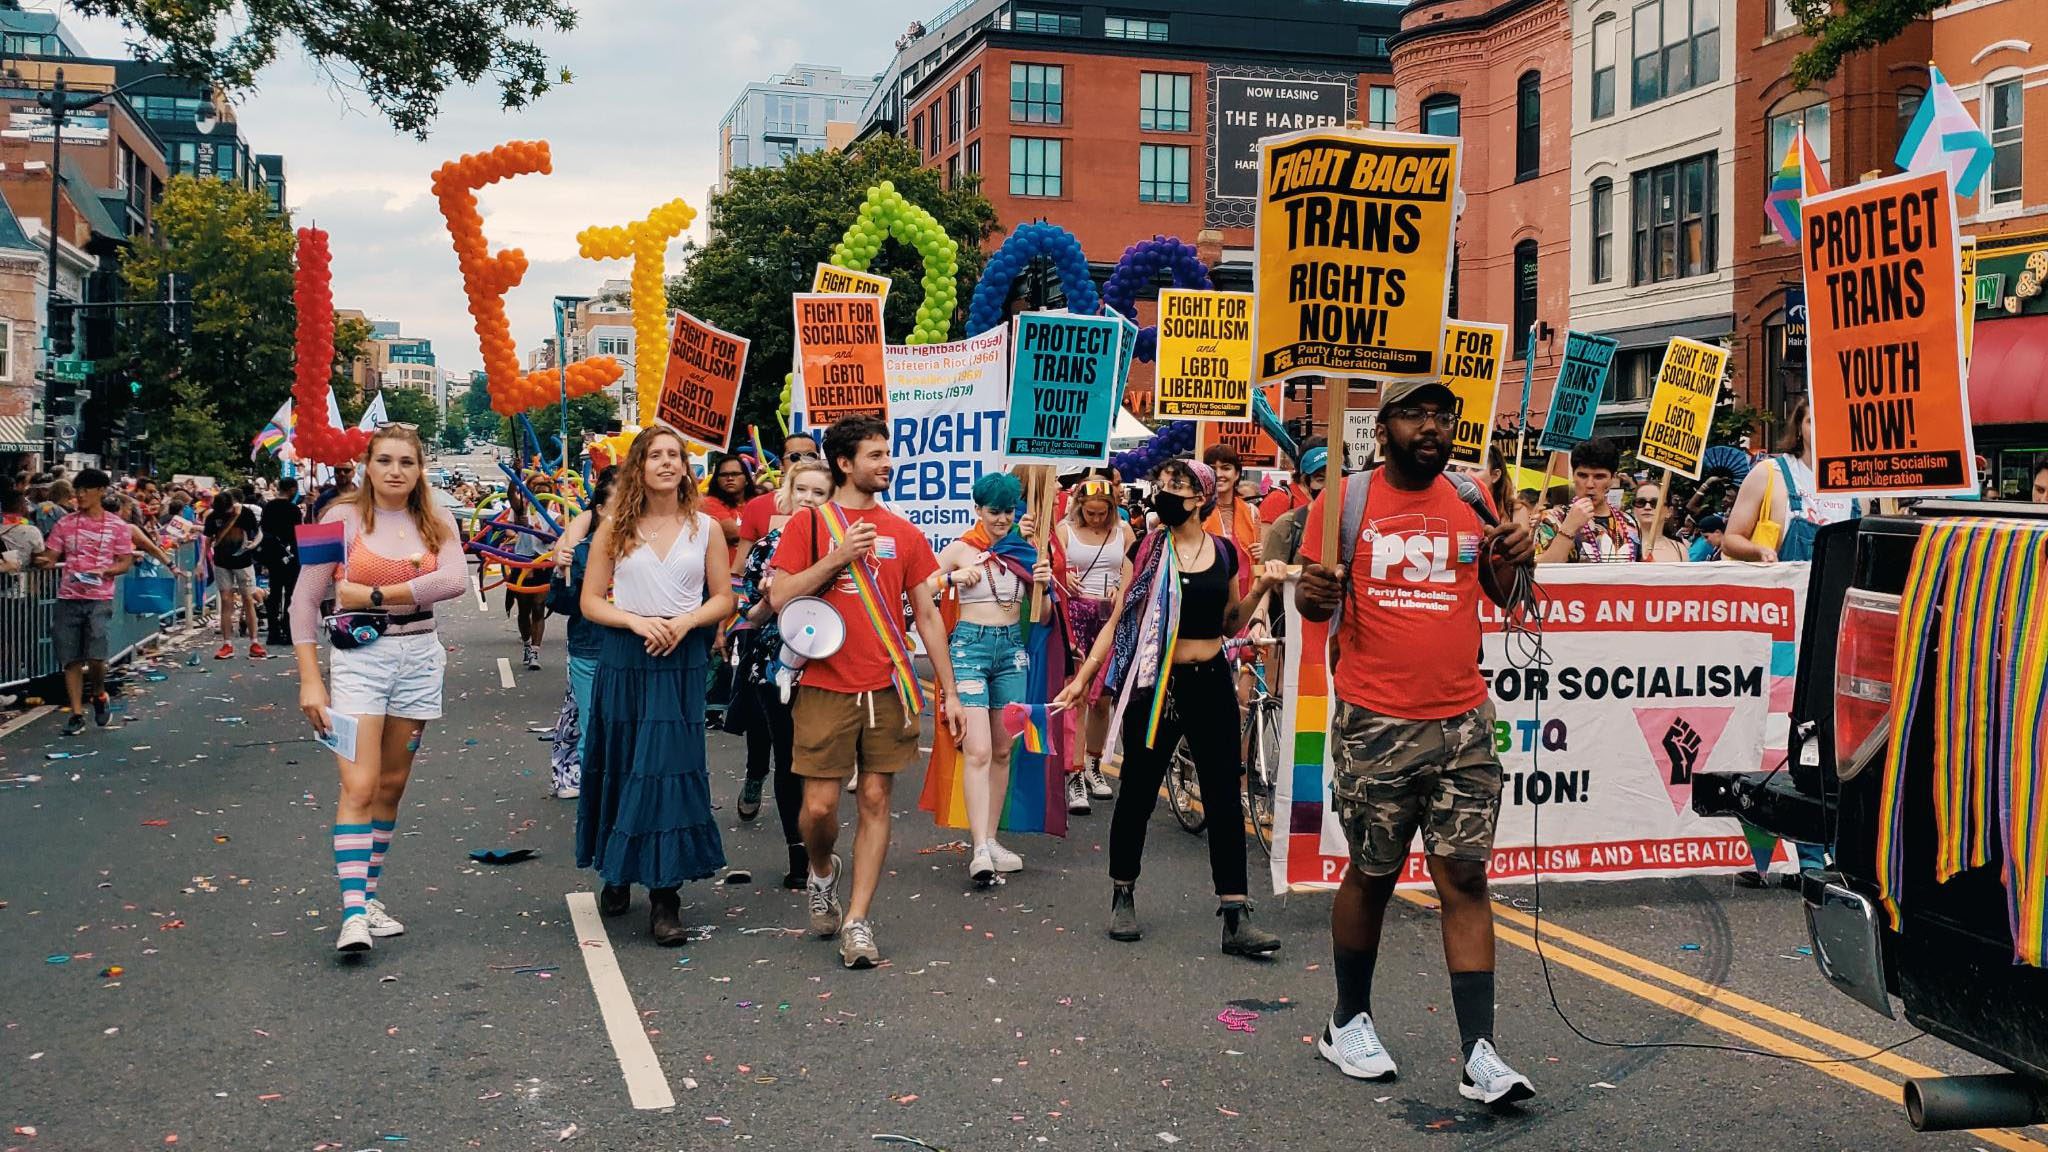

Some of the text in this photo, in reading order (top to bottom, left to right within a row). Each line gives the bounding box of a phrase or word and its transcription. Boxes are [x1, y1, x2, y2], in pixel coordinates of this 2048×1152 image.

[1247, 86, 1319, 101] NOW LEASING
[1226, 111, 1337, 129] THE HARPER
[1271, 148, 1449, 195] FIGHT BACK!
[1285, 196, 1422, 254] TRANS
[1809, 187, 1939, 272] PROTECT
[821, 272, 880, 293] FIGHT FOR
[1289, 262, 1406, 307] RIGHTS
[1826, 259, 1926, 330] TRANS
[804, 302, 874, 323] FIGHT FOR
[1168, 296, 1246, 319] FIGHT FOR
[802, 325, 879, 345] SOCIALISM
[1163, 317, 1249, 341] SOCIALISM
[1299, 303, 1389, 347] NOW!
[680, 320, 737, 362] FIGHT FOR
[1024, 323, 1112, 356] PROTECT
[1196, 341, 1219, 353] and
[1455, 331, 1493, 356] FOR
[1788, 337, 1803, 346] Hair
[673, 338, 736, 381] SOCIALISM
[833, 346, 854, 359] and
[887, 359, 940, 371] Cafeteria
[943, 356, 966, 369] Riot
[1297, 356, 1387, 370] and Liberation
[1298, 345, 1417, 362] Party for Socialism
[1669, 344, 1719, 375] FIGHT FOR
[64, 362, 71, 371] T
[689, 372, 709, 383] and
[823, 364, 864, 385] LGBTQ
[1033, 353, 1098, 385] TRANS
[1181, 356, 1229, 380] LGBTQ
[1838, 341, 1921, 399] YOUTH
[1161, 377, 1247, 400] LIBERATION
[1662, 363, 1717, 398] SOCIALISM
[677, 376, 713, 409] LGBTQ
[808, 384, 884, 407] LIBERATION
[888, 389, 909, 402] ight
[914, 389, 943, 401] Riots
[1034, 388, 1089, 414] YOUTH
[661, 387, 727, 431] LIBERATION
[1181, 402, 1199, 411] Party
[1195, 408, 1226, 416] Liberation
[1665, 404, 1695, 432] LGBTQ
[1034, 414, 1081, 439] NOW!
[1217, 422, 1261, 435] YOUTH
[1350, 416, 1370, 424] RIGHT
[1848, 397, 1917, 452] NOW!
[892, 410, 1005, 458] RIGHT
[1031, 440, 1095, 450] Party for Socialism
[1220, 436, 1257, 454] NOW!
[1357, 428, 1376, 439] FRO
[1645, 421, 1701, 457] LIBERATION
[1828, 465, 1849, 486] PSL
[1851, 455, 1948, 477] Party for Socialism
[1851, 473, 1869, 486] and
[904, 505, 975, 526] acism,
[1370, 533, 1456, 583] PSL
[1367, 587, 1458, 601] Party for Socialism
[1379, 599, 1449, 611] and Liberation
[1596, 600, 1634, 623] AN
[1645, 600, 1789, 627] UPRISING!
[1558, 665, 1764, 701] SOCIALISM
[1495, 719, 1567, 753] BTQ
[1590, 845, 1633, 867] AND
[1640, 839, 1752, 864] LIBERATIO
